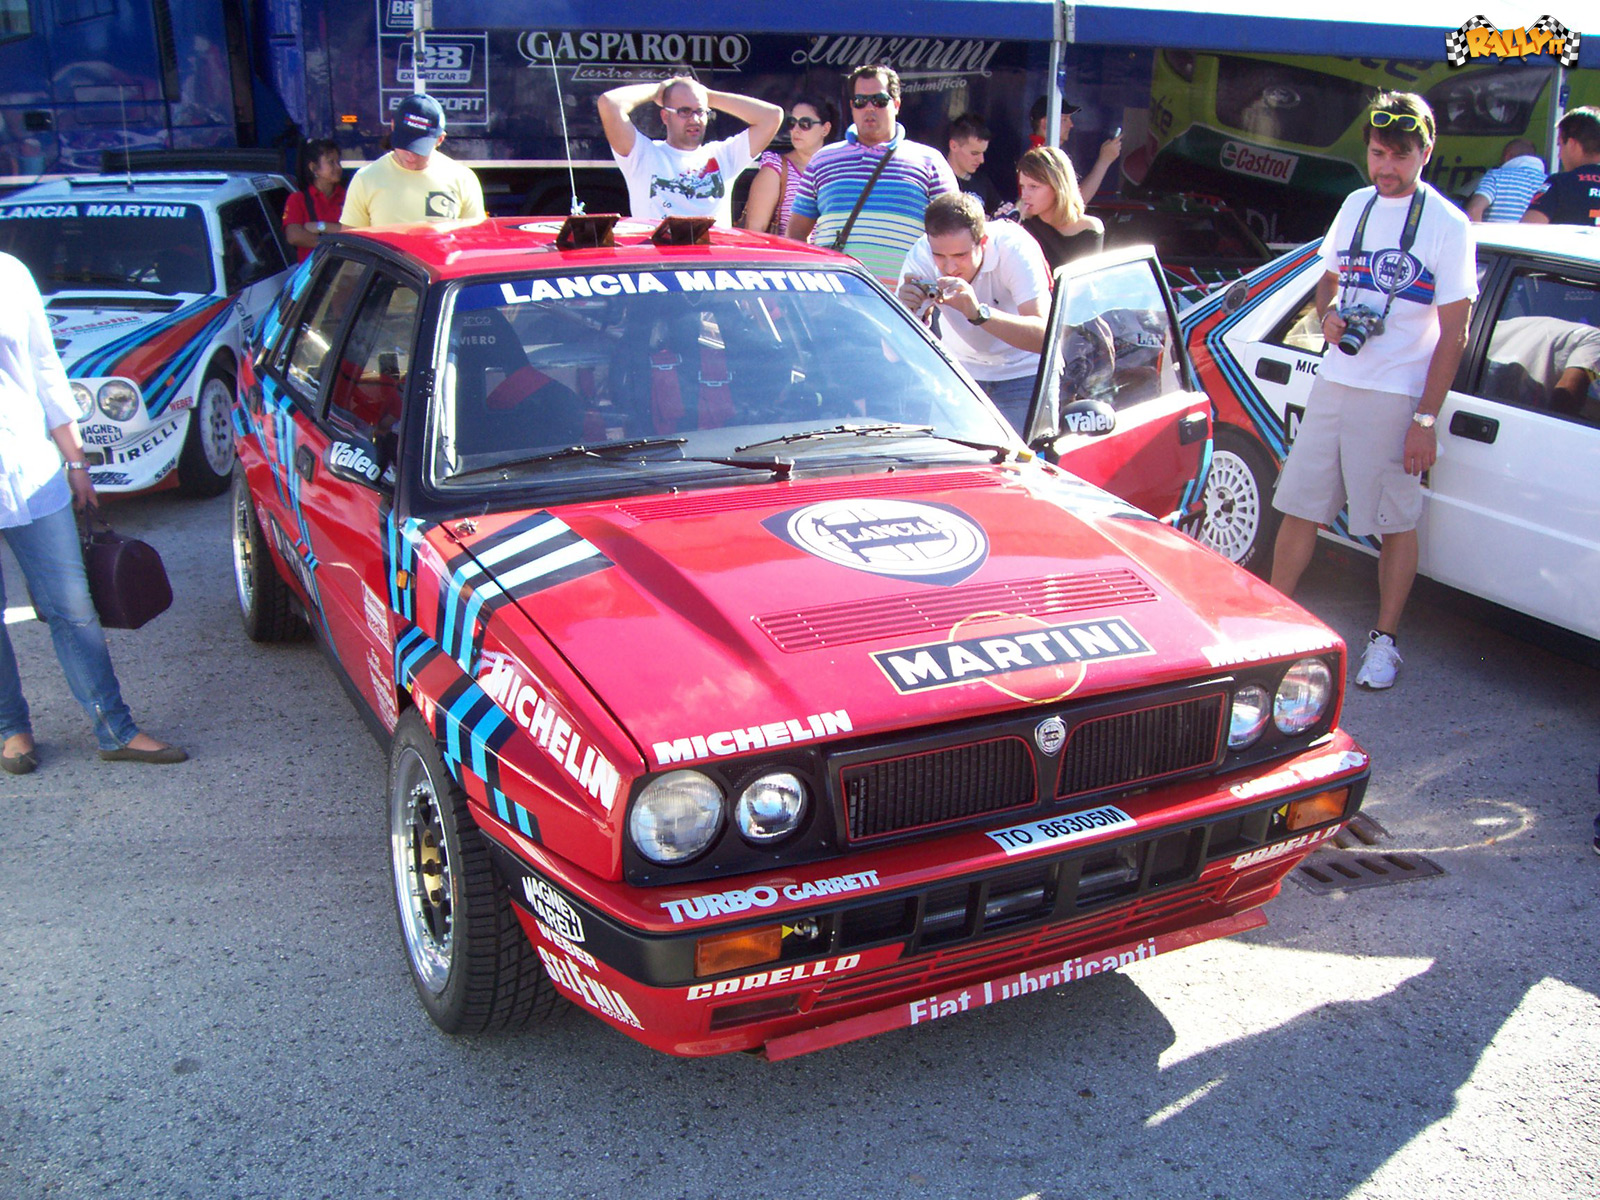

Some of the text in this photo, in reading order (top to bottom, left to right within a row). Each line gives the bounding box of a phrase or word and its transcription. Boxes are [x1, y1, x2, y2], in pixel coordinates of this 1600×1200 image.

[526, 31, 743, 63] GASPAROTTO
[580, 67, 632, 78] centro
[1236, 148, 1291, 179] Castrol
[0, 205, 187, 219] LANCIA MARTINI
[500, 270, 845, 304] LANCIA MARTINI
[459, 335, 497, 345] VIERO
[1065, 411, 1115, 433] Valeo
[330, 441, 381, 481] Valeo
[837, 520, 937, 543] LANCIA
[887, 622, 1140, 686] MARTINI
[489, 655, 620, 811] MICHELIN
[652, 709, 854, 765] MICHELIN
[993, 808, 1126, 847] TO 86305M
[521, 876, 583, 925] MAGNETI
[660, 869, 880, 924] TURBO GARRETT
[528, 893, 586, 942] MARELLI
[535, 919, 600, 972] WEBER
[686, 954, 861, 1000] CARELLO
[908, 990, 972, 1025] Fiat
